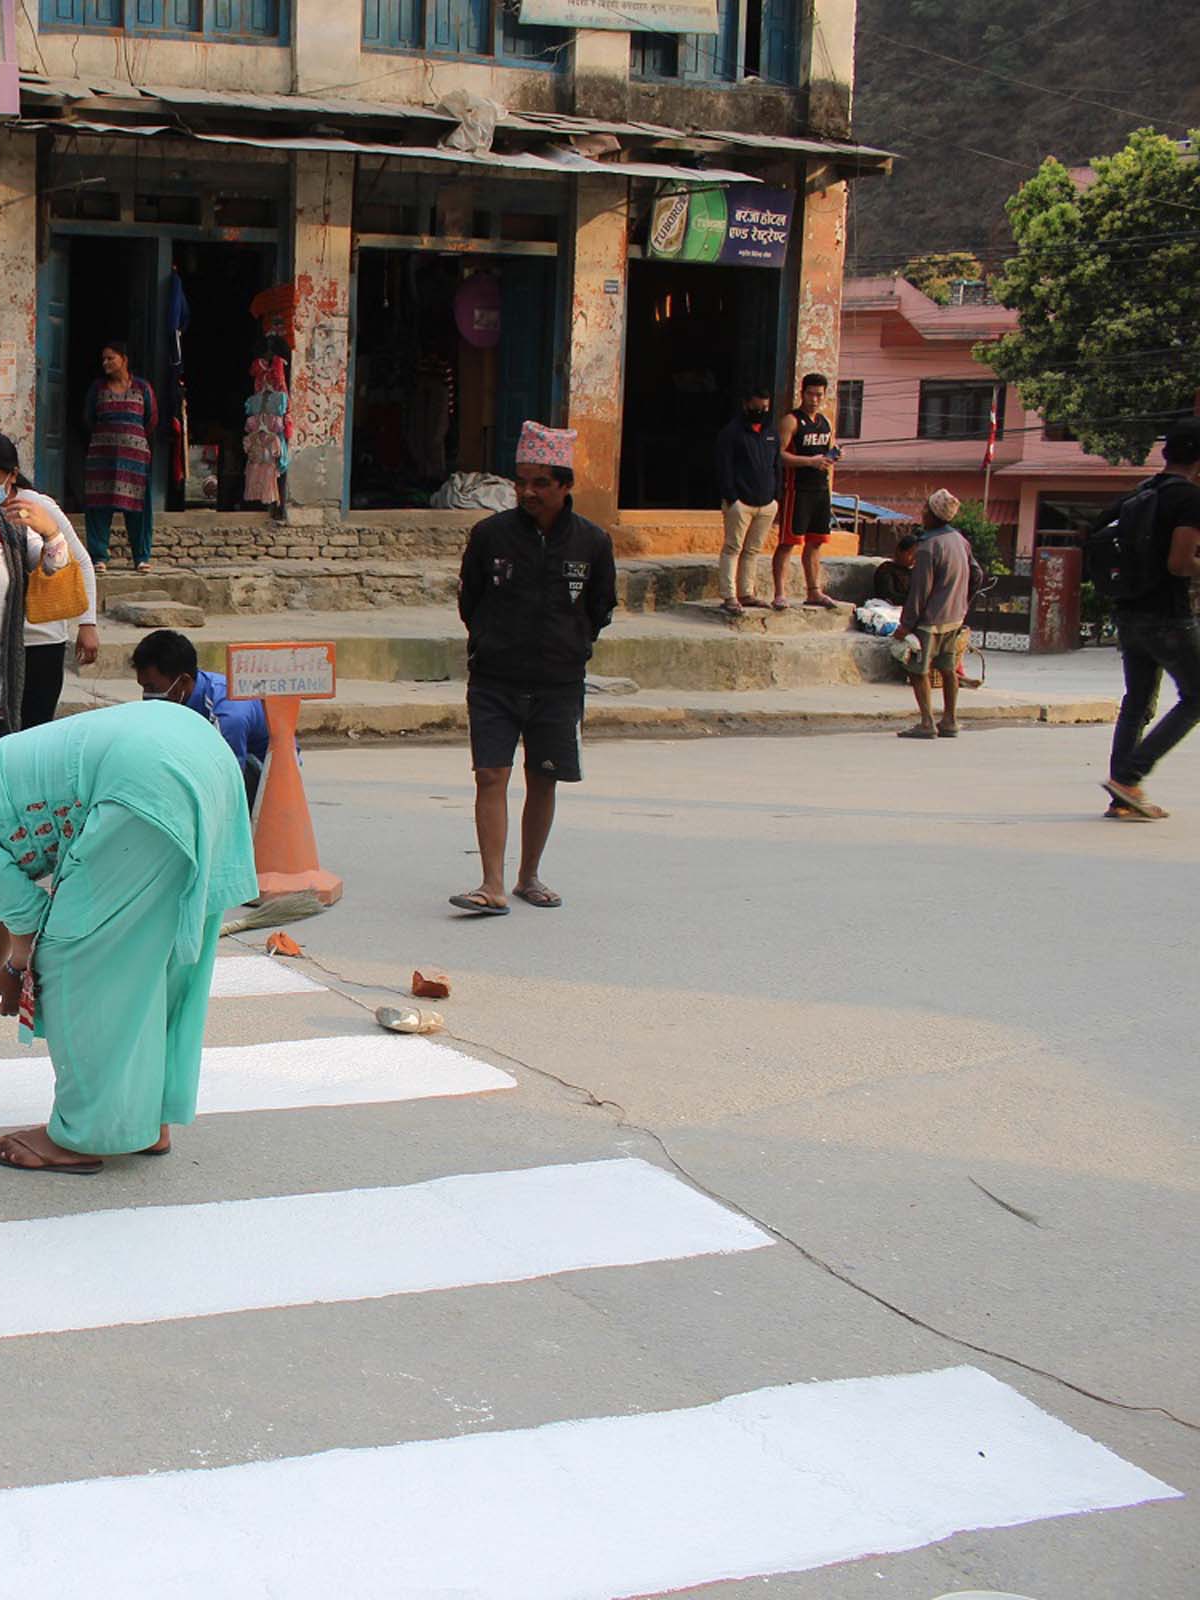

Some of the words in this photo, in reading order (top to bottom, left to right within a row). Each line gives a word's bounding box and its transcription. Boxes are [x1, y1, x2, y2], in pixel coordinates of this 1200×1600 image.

[760, 209, 787, 227] होटल
[802, 432, 830, 446] HEAT
[237, 679, 287, 694] WATER
[291, 678, 326, 692] TANK
